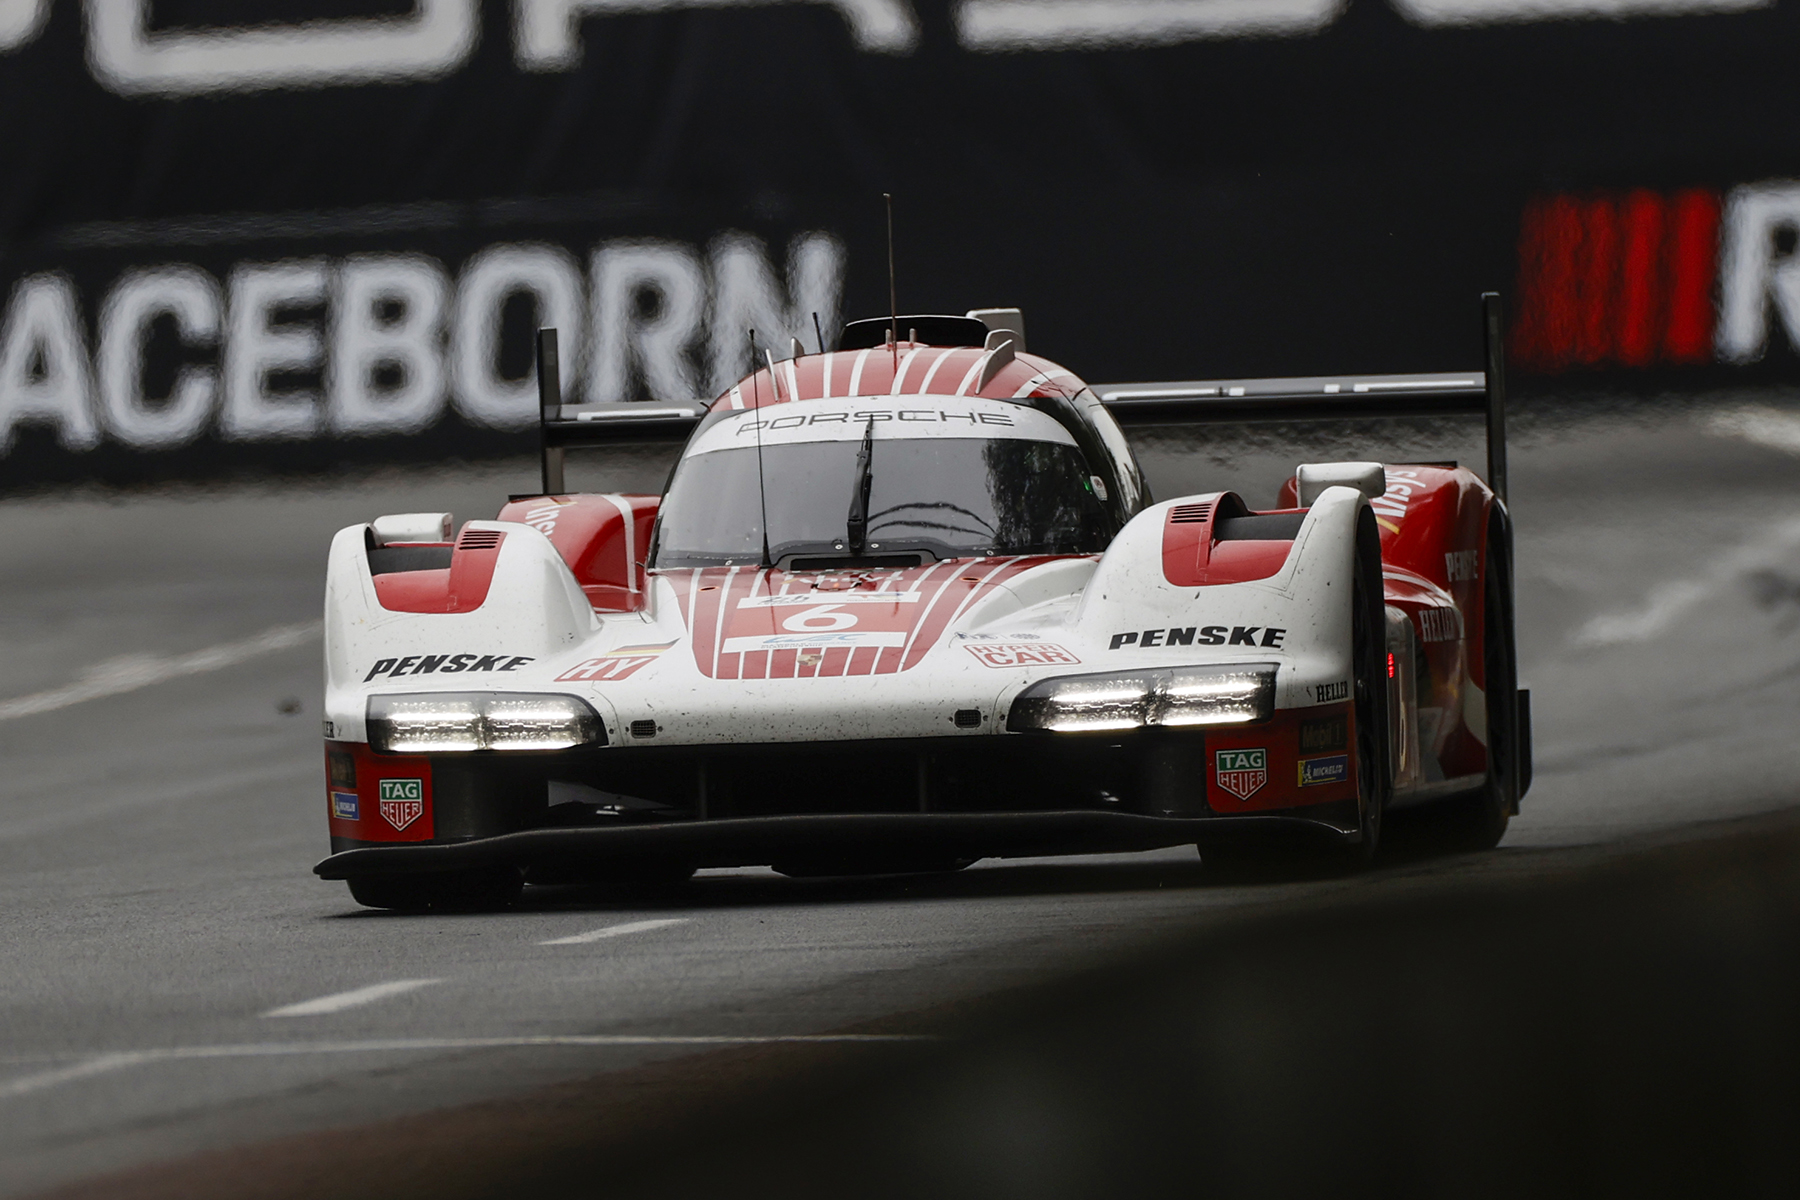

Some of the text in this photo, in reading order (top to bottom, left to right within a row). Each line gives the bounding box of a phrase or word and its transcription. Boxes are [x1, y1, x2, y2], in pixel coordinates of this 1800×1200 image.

[736, 409, 1015, 437] PORSCHE
[781, 604, 859, 632] 6
[972, 643, 1060, 654] HYPER
[1109, 625, 1288, 651] PENSKE
[363, 654, 536, 683] PENSKE
[560, 656, 649, 681] HY
[983, 651, 1072, 667] CAR
[1316, 680, 1349, 703] HELLER
[1221, 752, 1263, 770] TAG
[1312, 764, 1344, 778] MICHELIN
[382, 782, 419, 799] TAG
[1219, 770, 1265, 797] HEUER
[380, 802, 422, 830] HEUER
